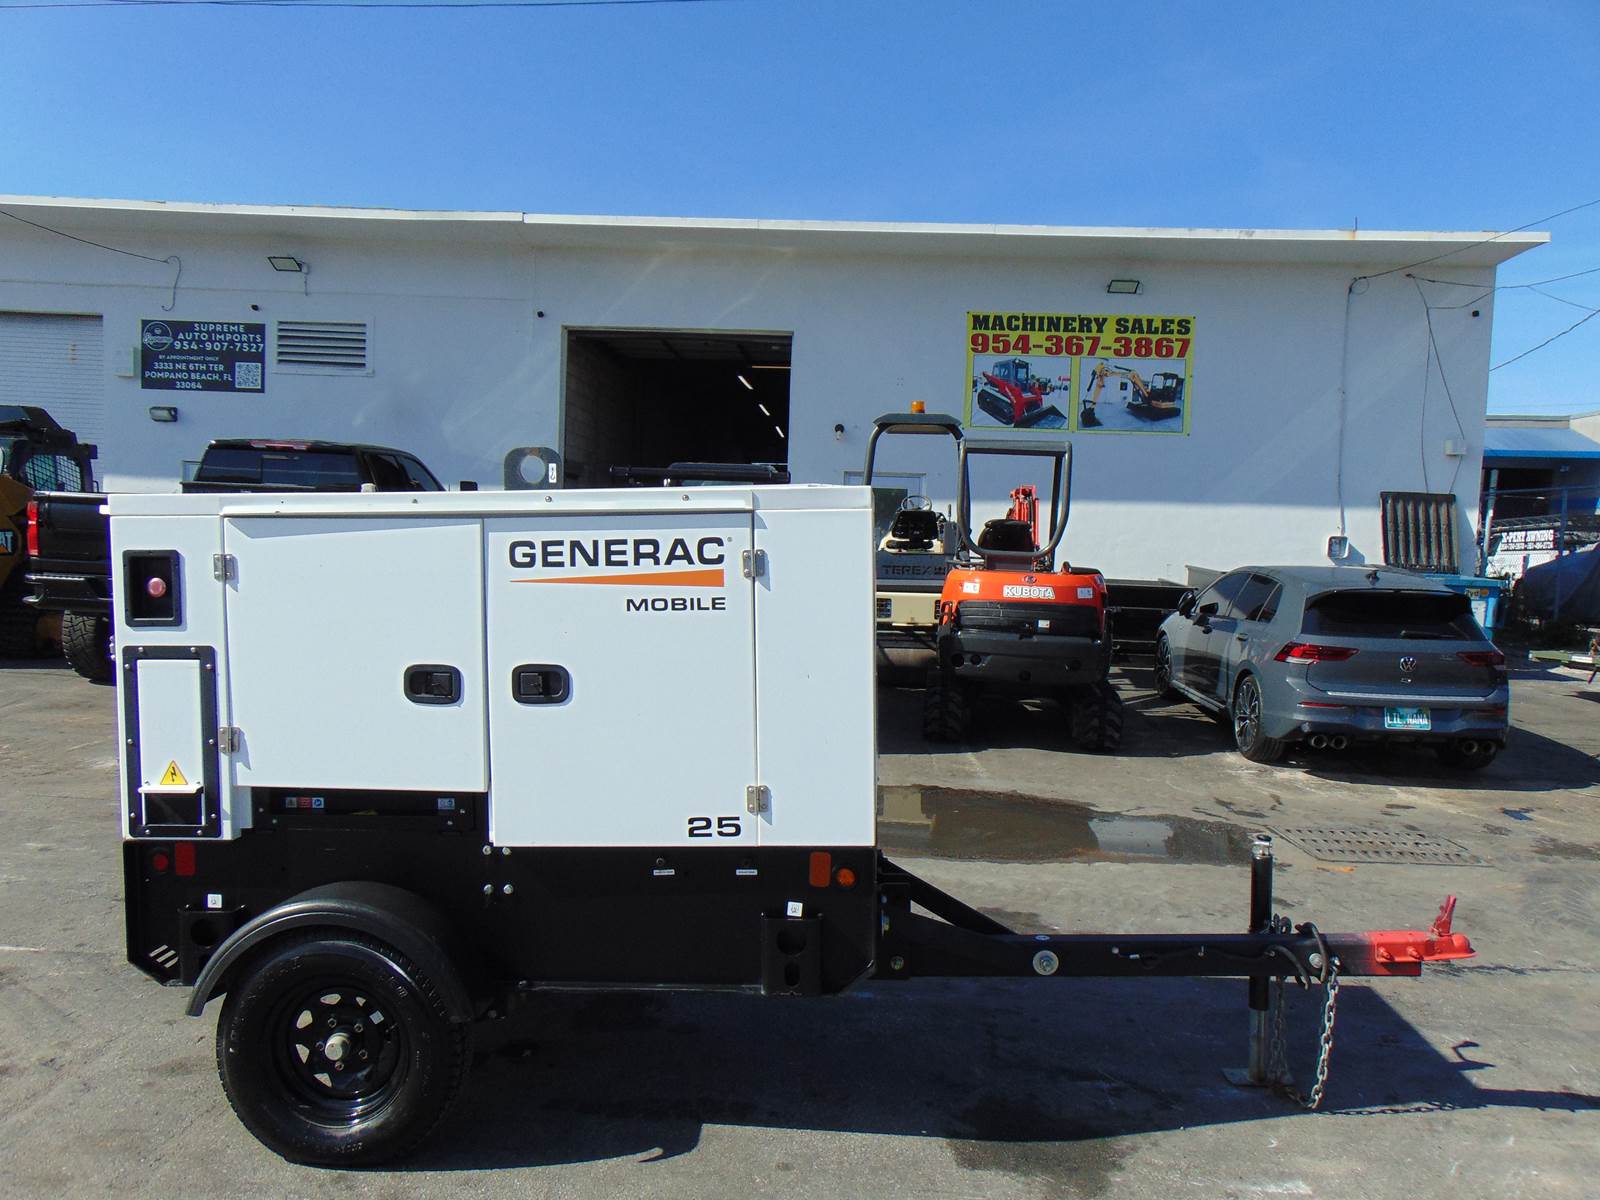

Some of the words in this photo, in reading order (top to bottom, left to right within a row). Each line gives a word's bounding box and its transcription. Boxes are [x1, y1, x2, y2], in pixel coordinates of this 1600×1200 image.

[194, 323, 245, 333] SUPREME
[972, 314, 1108, 334] MACHINERY
[1115, 317, 1191, 335] SALES
[177, 332, 208, 341] AUTO
[211, 333, 262, 343] IMPORTS
[174, 341, 264, 353] 954-907-7527
[970, 332, 1191, 359] 954-367-3867
[153, 362, 174, 370] 3333
[175, 362, 186, 370] NE
[188, 362, 207, 371] 6TH
[209, 363, 225, 371] TER
[145, 371, 190, 380] POMPANO
[223, 373, 233, 381] FL
[175, 381, 202, 389] 33064
[508, 536, 726, 569] GENERAC
[881, 564, 932, 576] TEREX
[1003, 586, 1056, 599] KUBOTA
[626, 597, 726, 612] MOBILE
[687, 816, 742, 838] 25
